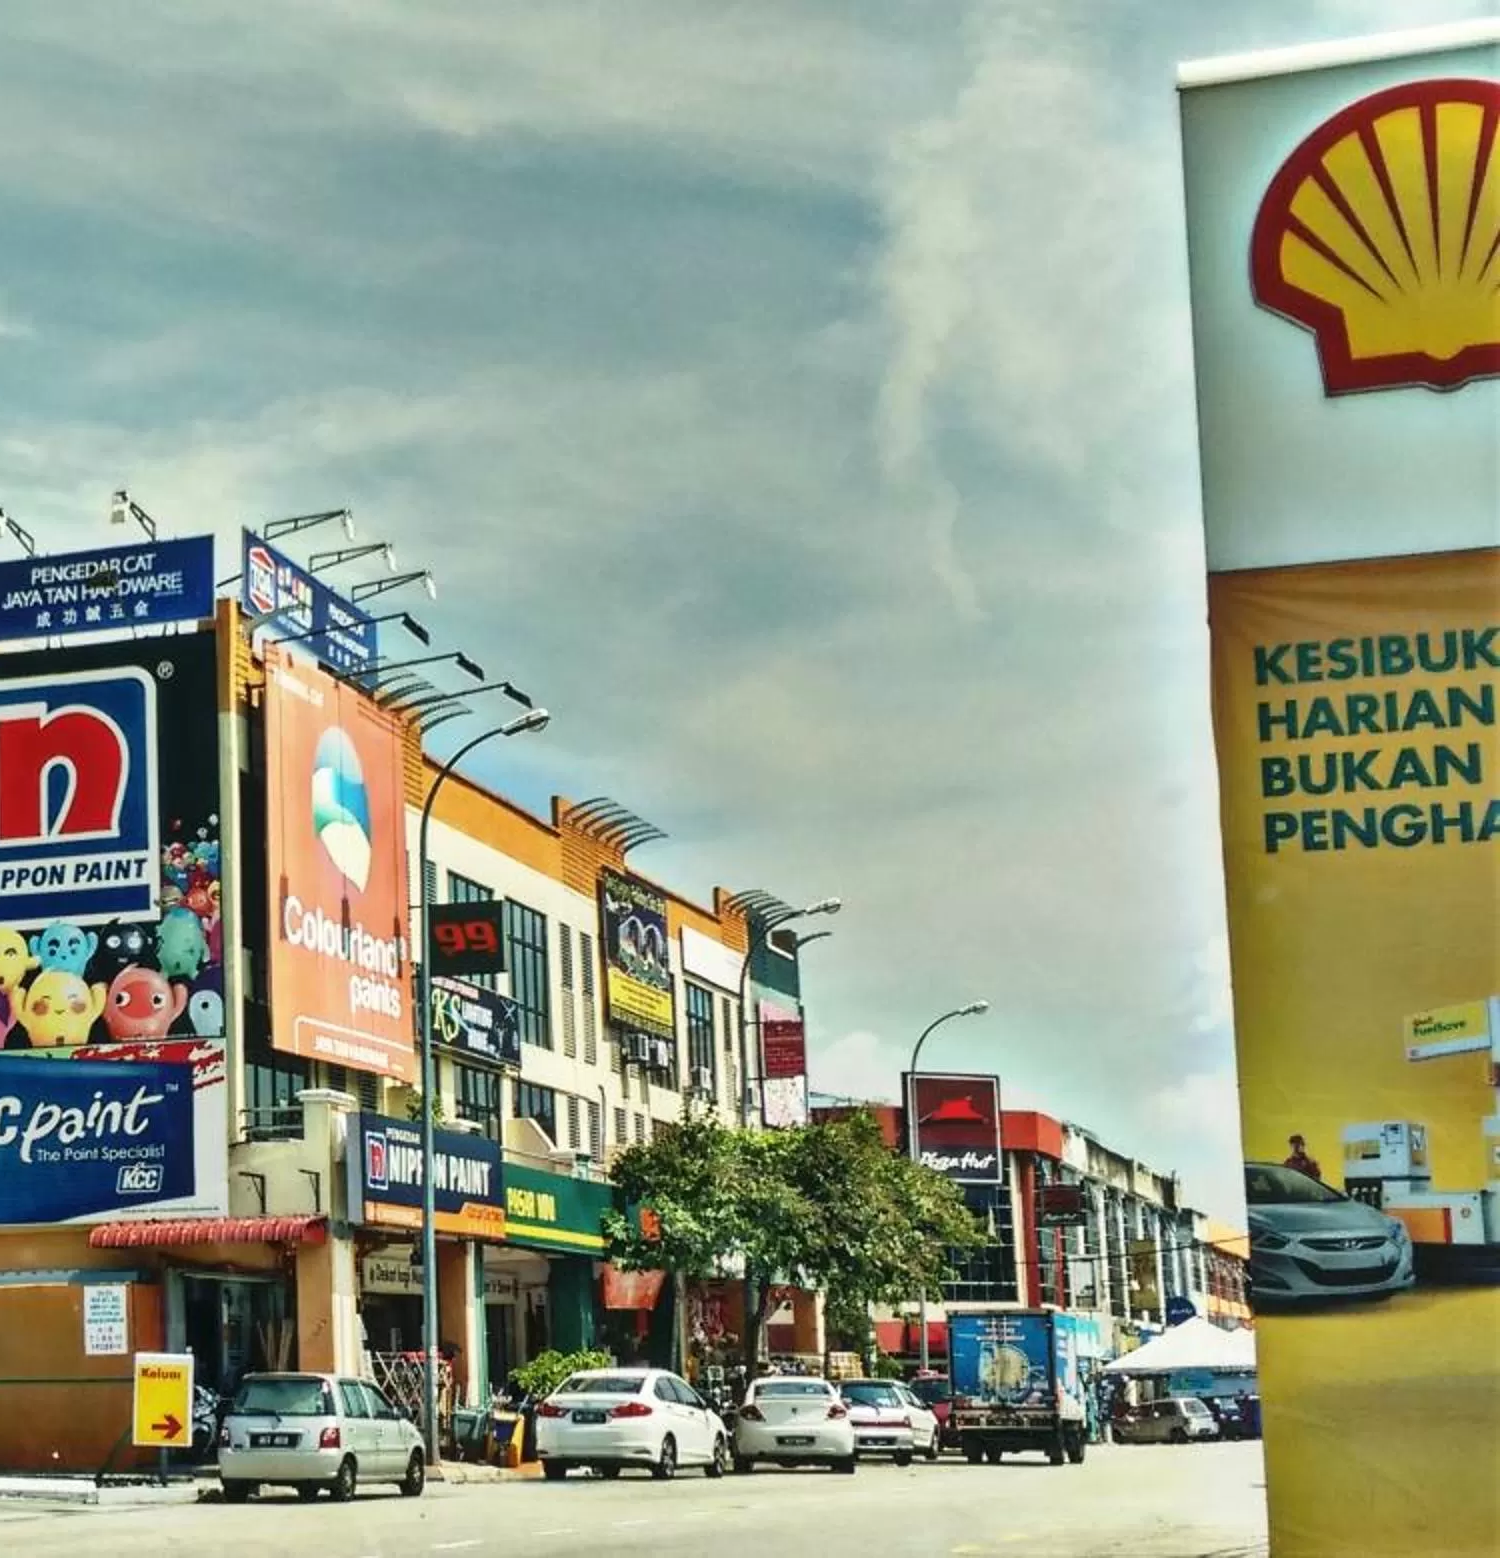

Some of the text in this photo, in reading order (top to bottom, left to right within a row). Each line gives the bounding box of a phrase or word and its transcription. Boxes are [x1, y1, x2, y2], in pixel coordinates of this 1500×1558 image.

[31, 553, 156, 585] PENGEDAR CAT
[2, 590, 43, 610] JAYA
[45, 585, 77, 604] TAN
[1254, 627, 1500, 686] KESIBUK
[1257, 684, 1495, 742] HARIAN
[1261, 742, 1482, 798] BUKAN
[74, 858, 148, 883] PAINT
[350, 974, 402, 1020] paints
[1413, 1020, 1468, 1037] FuelSave
[20, 1086, 164, 1163] paint
[37, 1144, 165, 1163] The Paint Specialist
[920, 1151, 996, 1171] Pizza Hut
[121, 1167, 158, 1189] KCC
[389, 1144, 492, 1196] NIPPN PAINT
